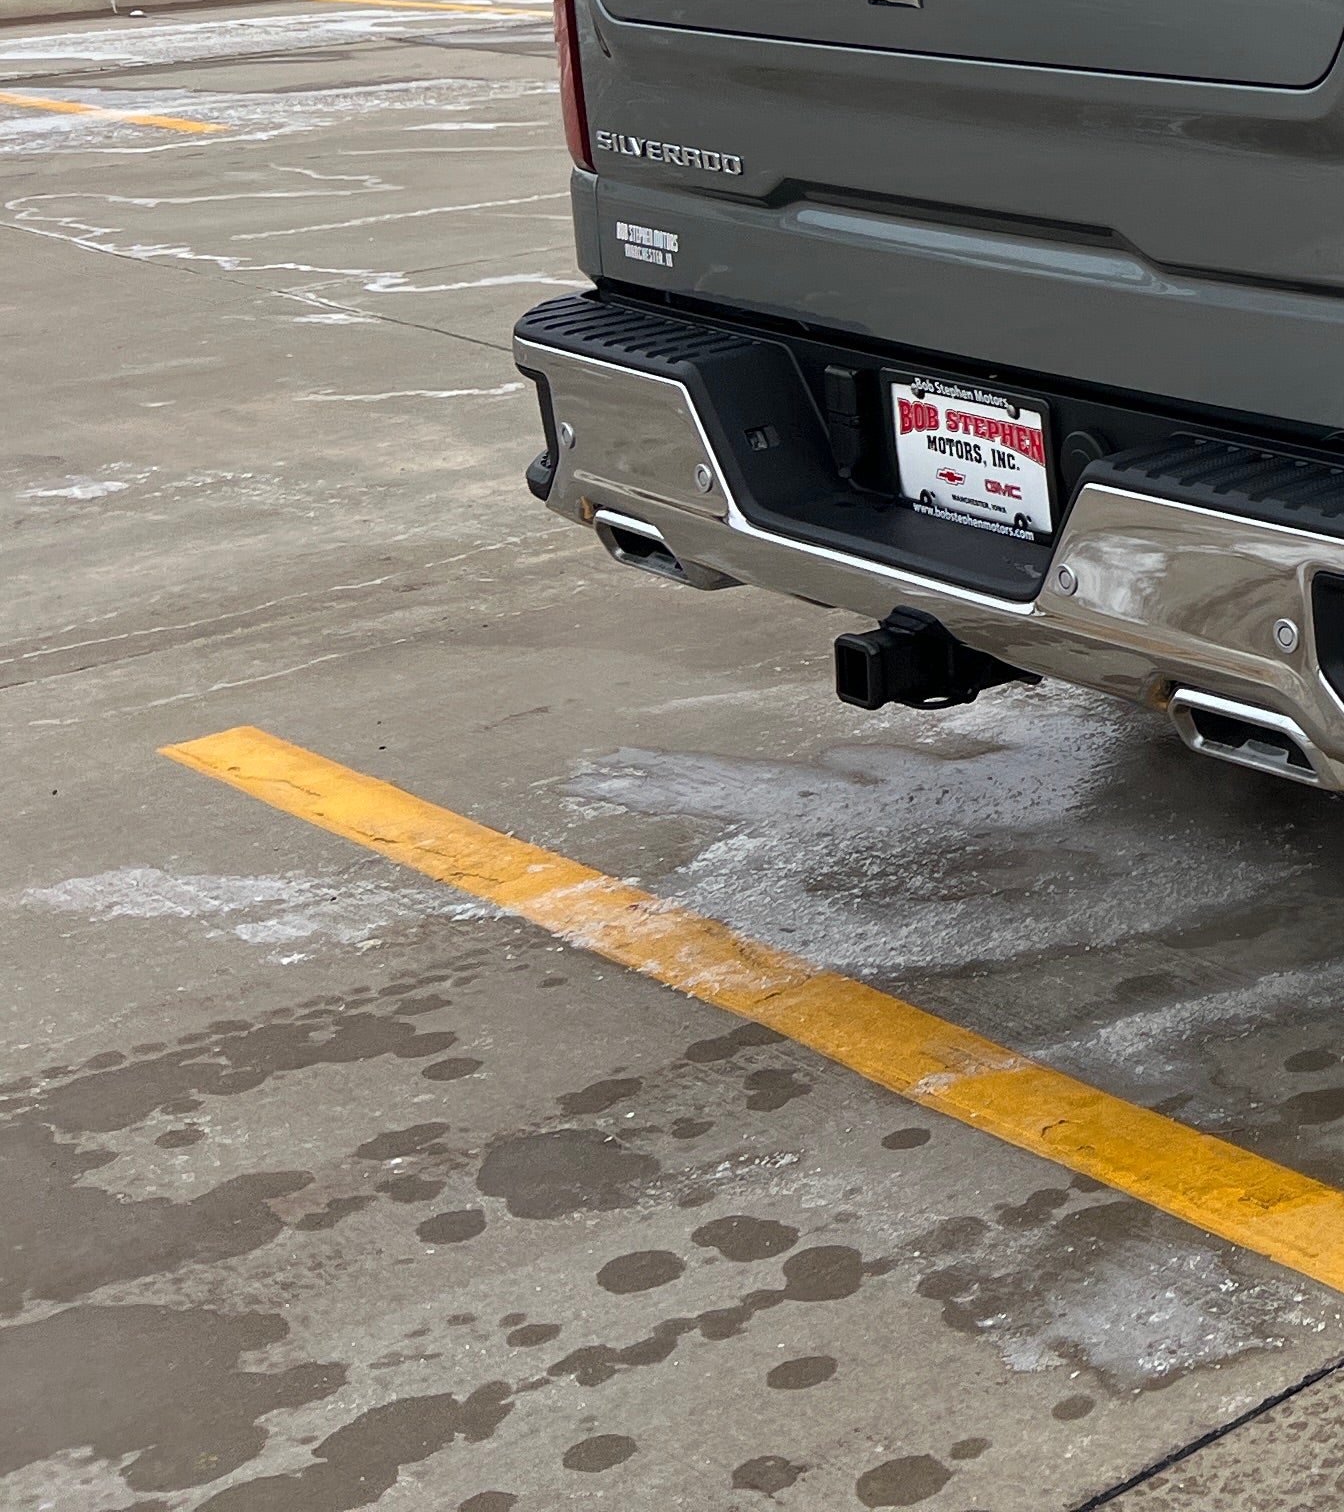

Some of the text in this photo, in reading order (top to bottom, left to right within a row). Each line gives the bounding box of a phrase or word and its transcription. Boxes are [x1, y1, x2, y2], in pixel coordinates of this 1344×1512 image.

[596, 130, 745, 176] SILVERADO
[914, 377, 1010, 407] Bob Stephen Motors
[898, 397, 1046, 466] BOB STEPHEN
[926, 434, 1021, 471] MOTORS, INC.
[984, 478, 1022, 501] GMC
[912, 502, 1035, 541] www.bobstephenmotors.com
